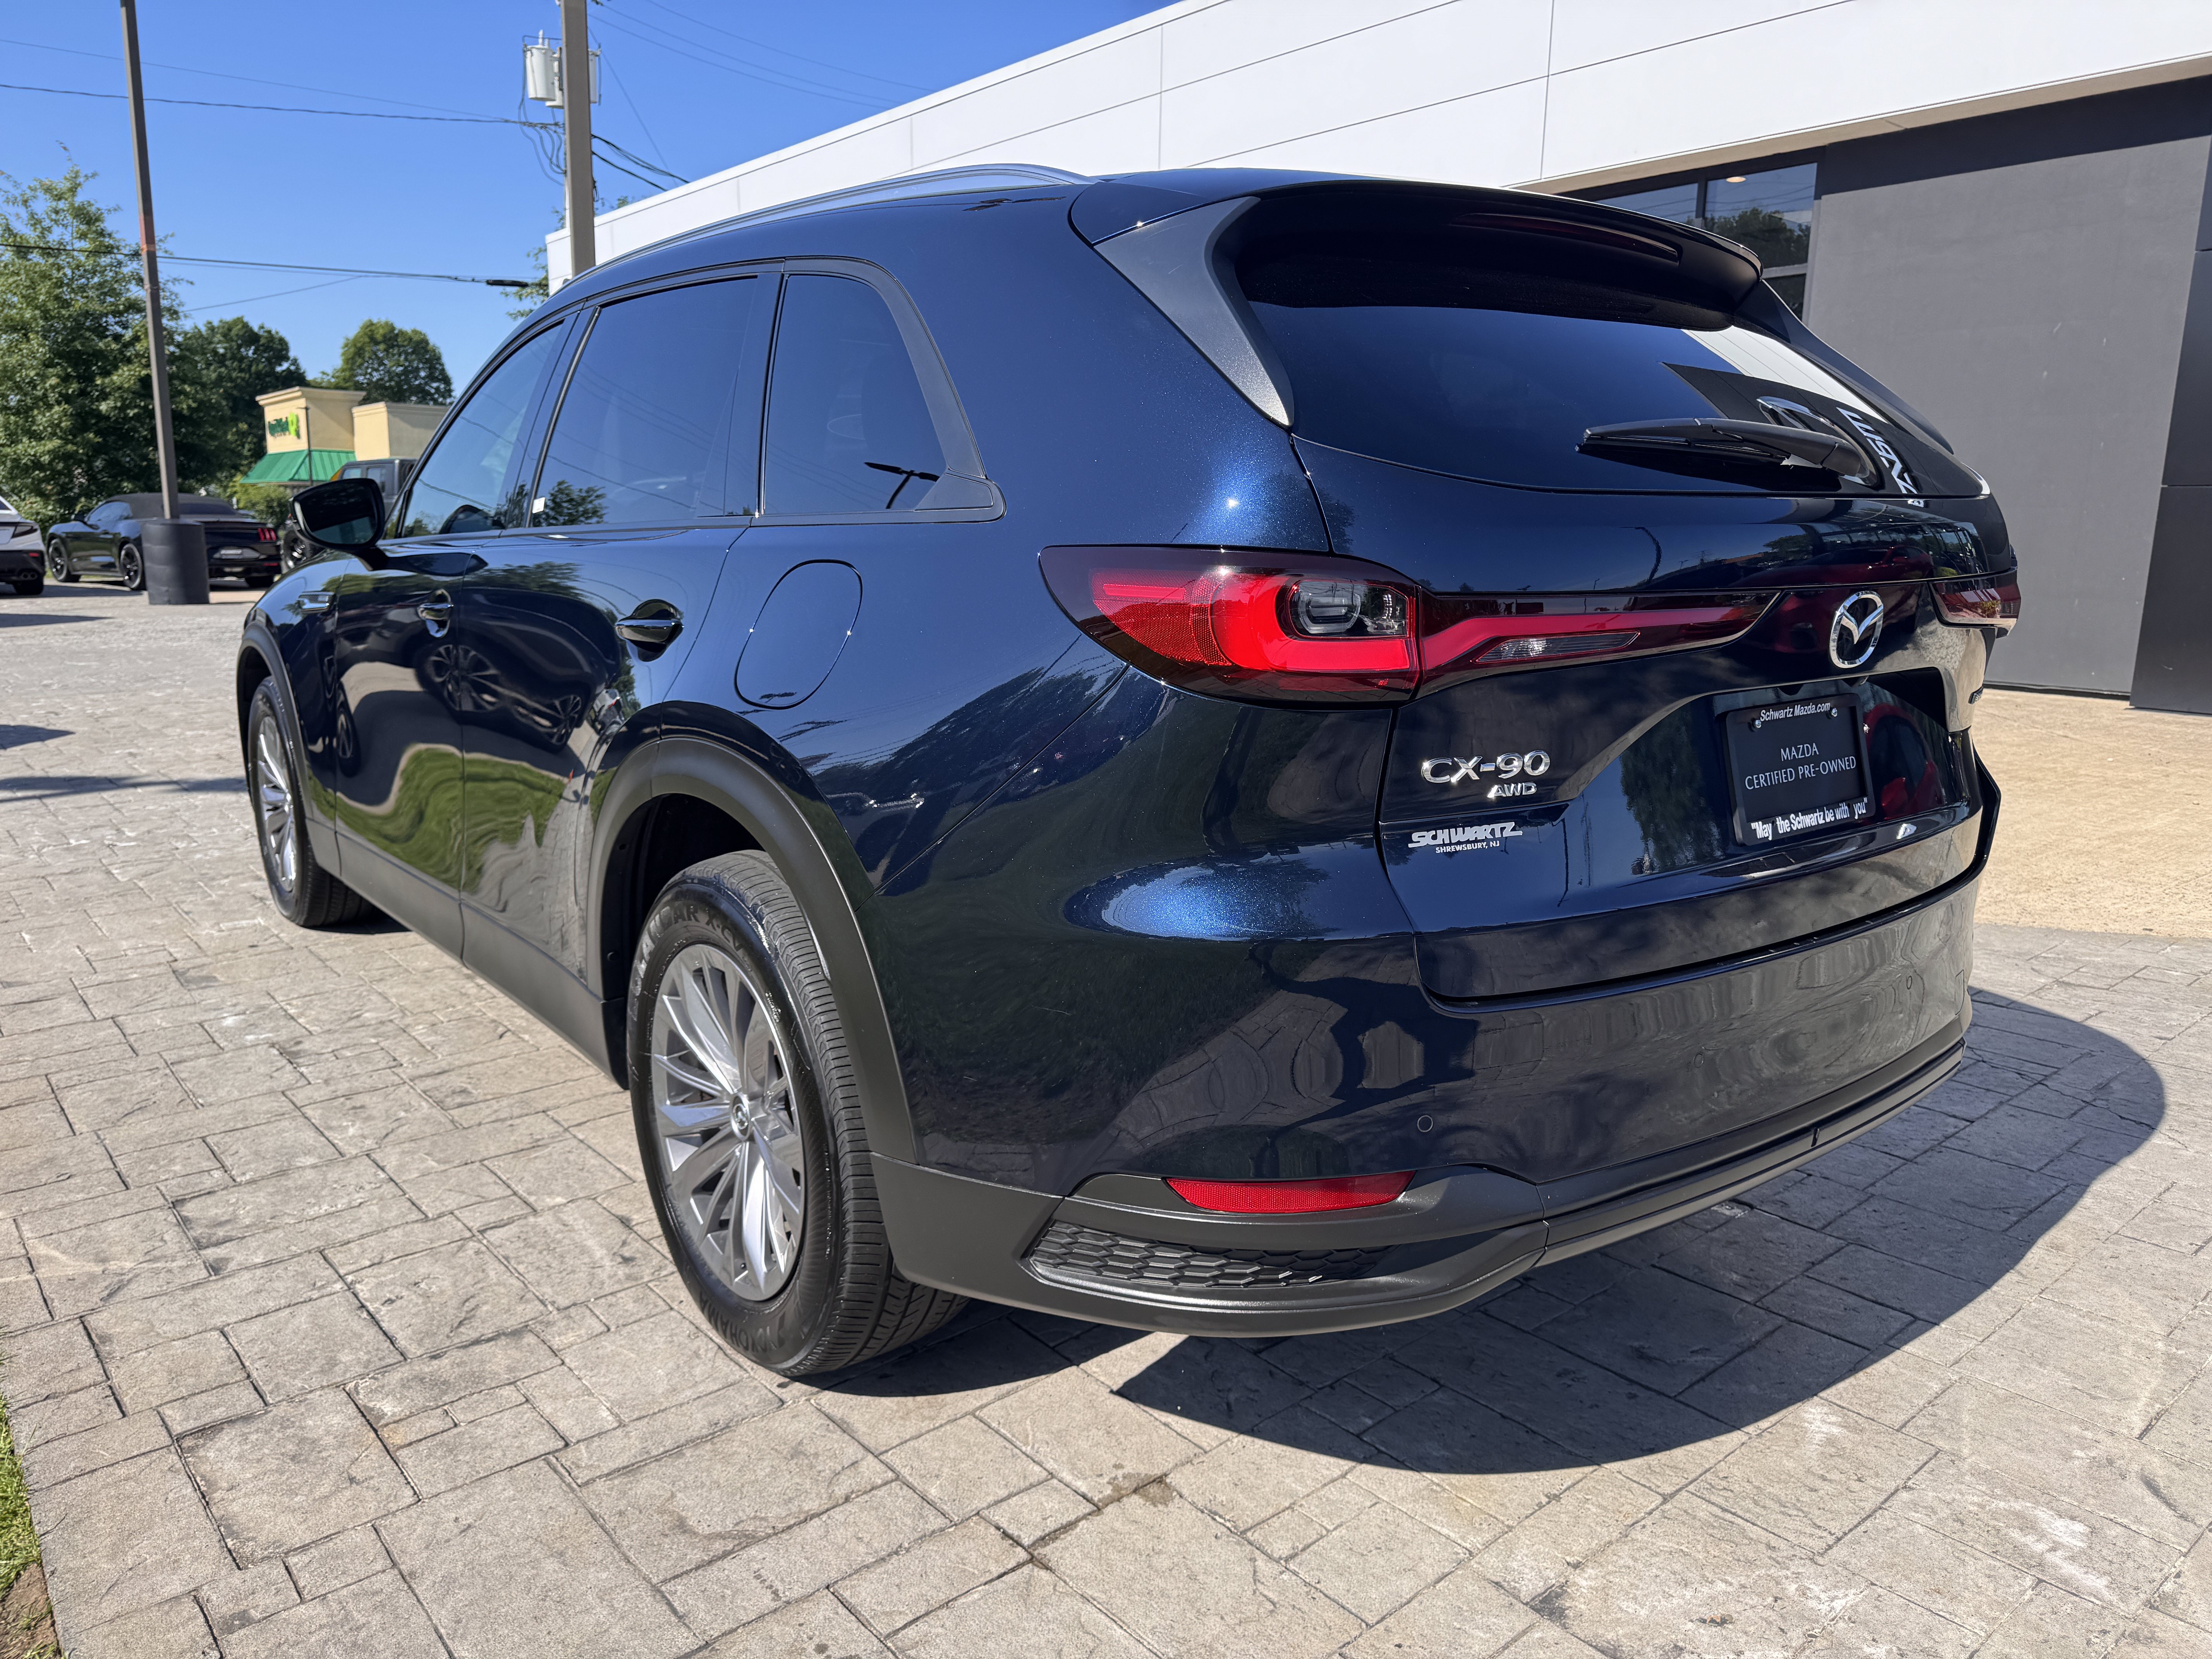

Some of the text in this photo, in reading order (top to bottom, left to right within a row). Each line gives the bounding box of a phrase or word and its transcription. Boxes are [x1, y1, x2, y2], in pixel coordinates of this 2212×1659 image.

[1760, 702, 1831, 721] Schwartz Mazda.com
[1781, 743, 1819, 761] MAZDA
[1421, 750, 1550, 783] CX-90
[1745, 756, 1856, 790] CERTIFIED PRE-OWNED
[1487, 781, 1537, 798] AWD
[1751, 797, 1868, 841] "May the Schwartz be with you"
[1408, 822, 1523, 848] SCHWARTZ
[1436, 842, 1488, 854] SHREWSBURY,
